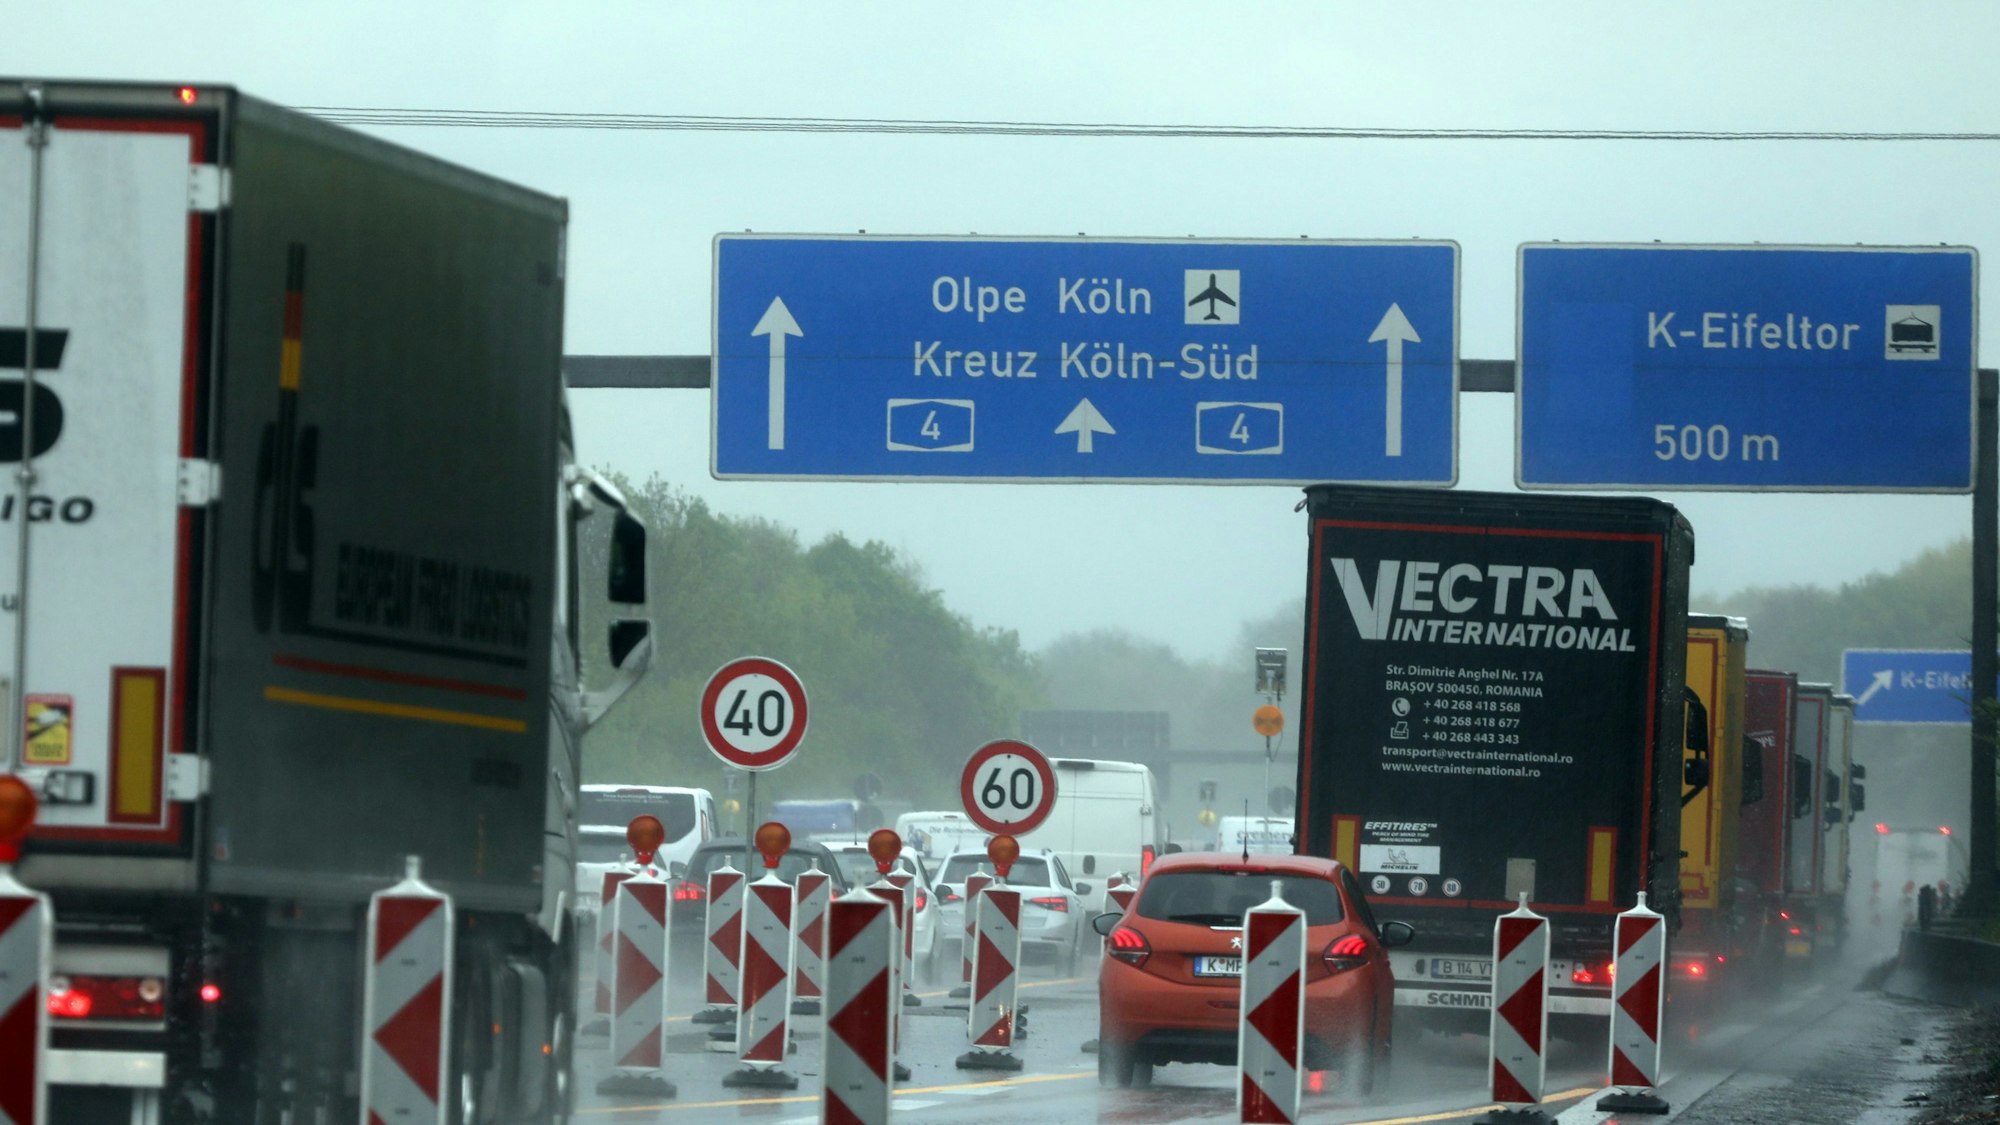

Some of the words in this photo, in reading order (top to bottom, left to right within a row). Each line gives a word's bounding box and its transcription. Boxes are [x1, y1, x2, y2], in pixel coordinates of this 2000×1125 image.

[931, 276, 1026, 322] Olpe
[1059, 276, 1152, 315] Köln
[1647, 312, 1859, 350] K-Eifeltor
[913, 340, 1037, 378] Kreuz
[1061, 341, 1259, 380] Köln-Süd
[921, 410, 940, 440] 4
[1229, 412, 1249, 444] 4
[1654, 424, 1729, 461] 500
[1742, 433, 1779, 461] m
[1330, 557, 1618, 640] VECTRA
[1392, 618, 1636, 652] INTERNATIONAL
[1386, 664, 1406, 675] Str.
[1408, 665, 1456, 677] Dimitrie
[1458, 668, 1499, 681] Anghel
[1502, 669, 1518, 680] Nr.
[1522, 671, 1544, 682] 17A
[1437, 683, 1483, 695] 500450,
[1485, 685, 1543, 697] ROMANIA
[723, 689, 785, 736] 40
[1434, 699, 1449, 709] 40
[1451, 700, 1473, 710] 268
[1475, 701, 1497, 711] 418
[1499, 702, 1521, 712] 568
[1433, 715, 1448, 725] 40
[1450, 716, 1472, 726] 268
[1474, 717, 1495, 727] 418
[1498, 718, 1520, 728] 677
[1432, 731, 1447, 741] 40
[1450, 732, 1471, 743] 268
[1473, 733, 1495, 743] 443
[1498, 734, 1519, 745] 343
[1382, 745, 1573, 764] transport@vectrainternational.ro
[1381, 762, 1541, 777] www.vectrainternational.ro
[981, 767, 1035, 810] 60
[1376, 880, 1386, 889] 50
[1208, 959, 1217, 971] K
[1457, 963, 1472, 974] 114
